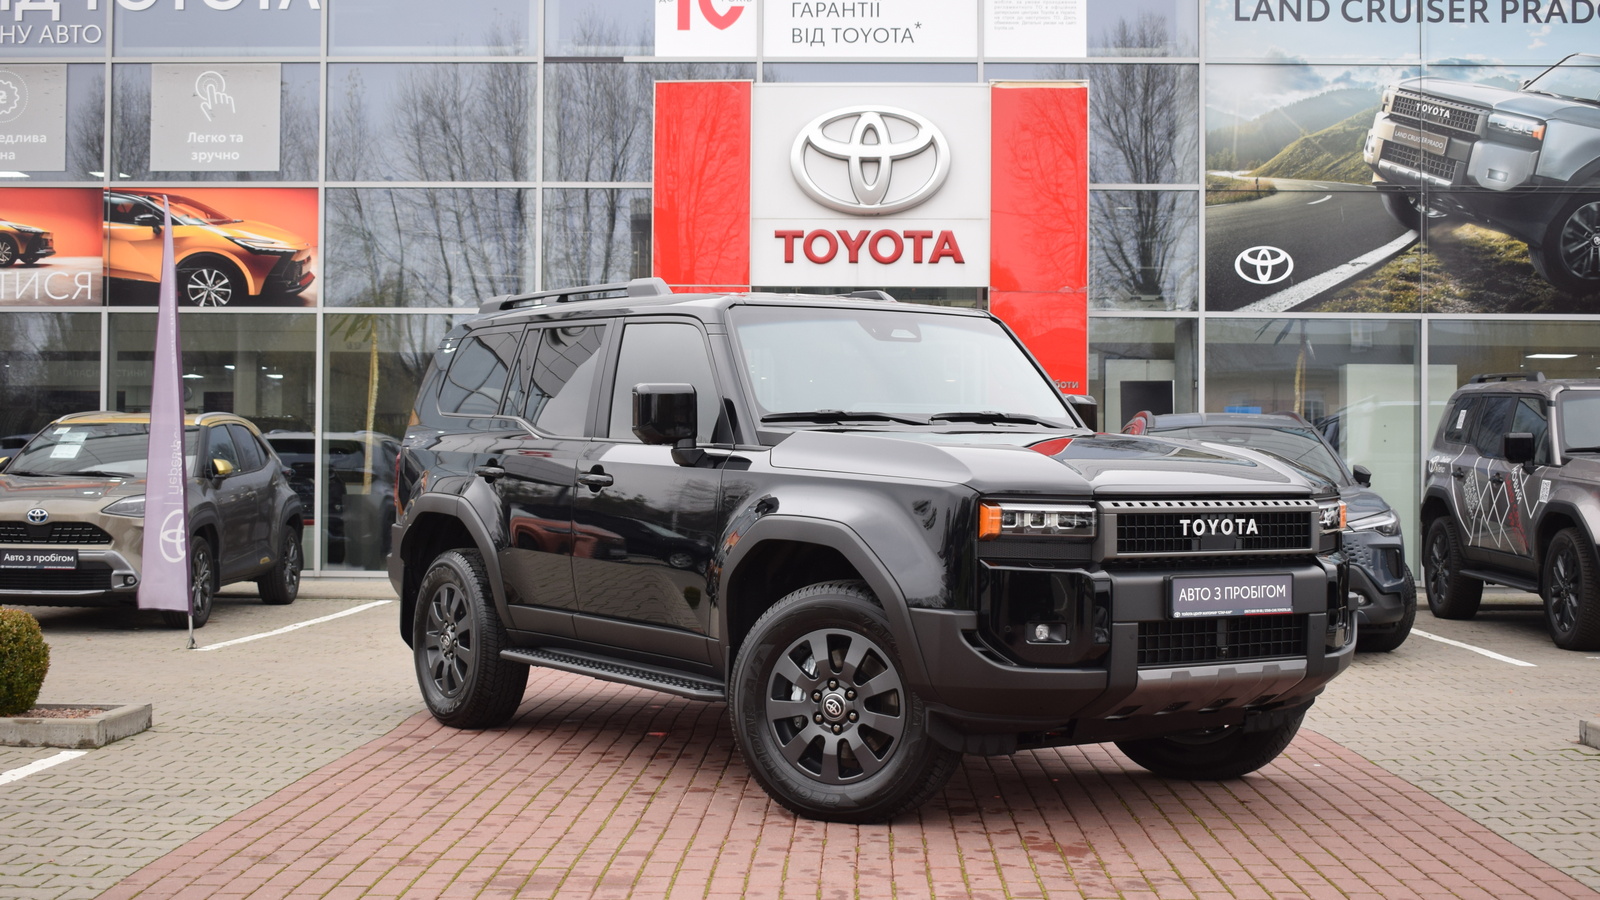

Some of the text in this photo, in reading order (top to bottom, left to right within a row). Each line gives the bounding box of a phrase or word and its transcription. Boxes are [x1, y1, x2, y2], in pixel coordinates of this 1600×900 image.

[1234, 0, 1330, 22] LAND
[1341, 0, 1490, 23] CRUISER
[0, 24, 102, 44] НУ АВТО
[792, 27, 825, 47] ВІД
[1416, 103, 1450, 119] TOYOTA
[0, 134, 47, 145] едлива
[187, 132, 244, 143] Легко та
[191, 151, 240, 163] зручно
[774, 228, 966, 265] TOYOTA
[0, 271, 92, 300] ТИСЯ
[1179, 518, 1259, 536] TOYOTA
[3, 553, 74, 563] Авто з пробігом
[1178, 587, 1211, 602] АВТО
[1224, 584, 1286, 600] ПРОБІГОМ
